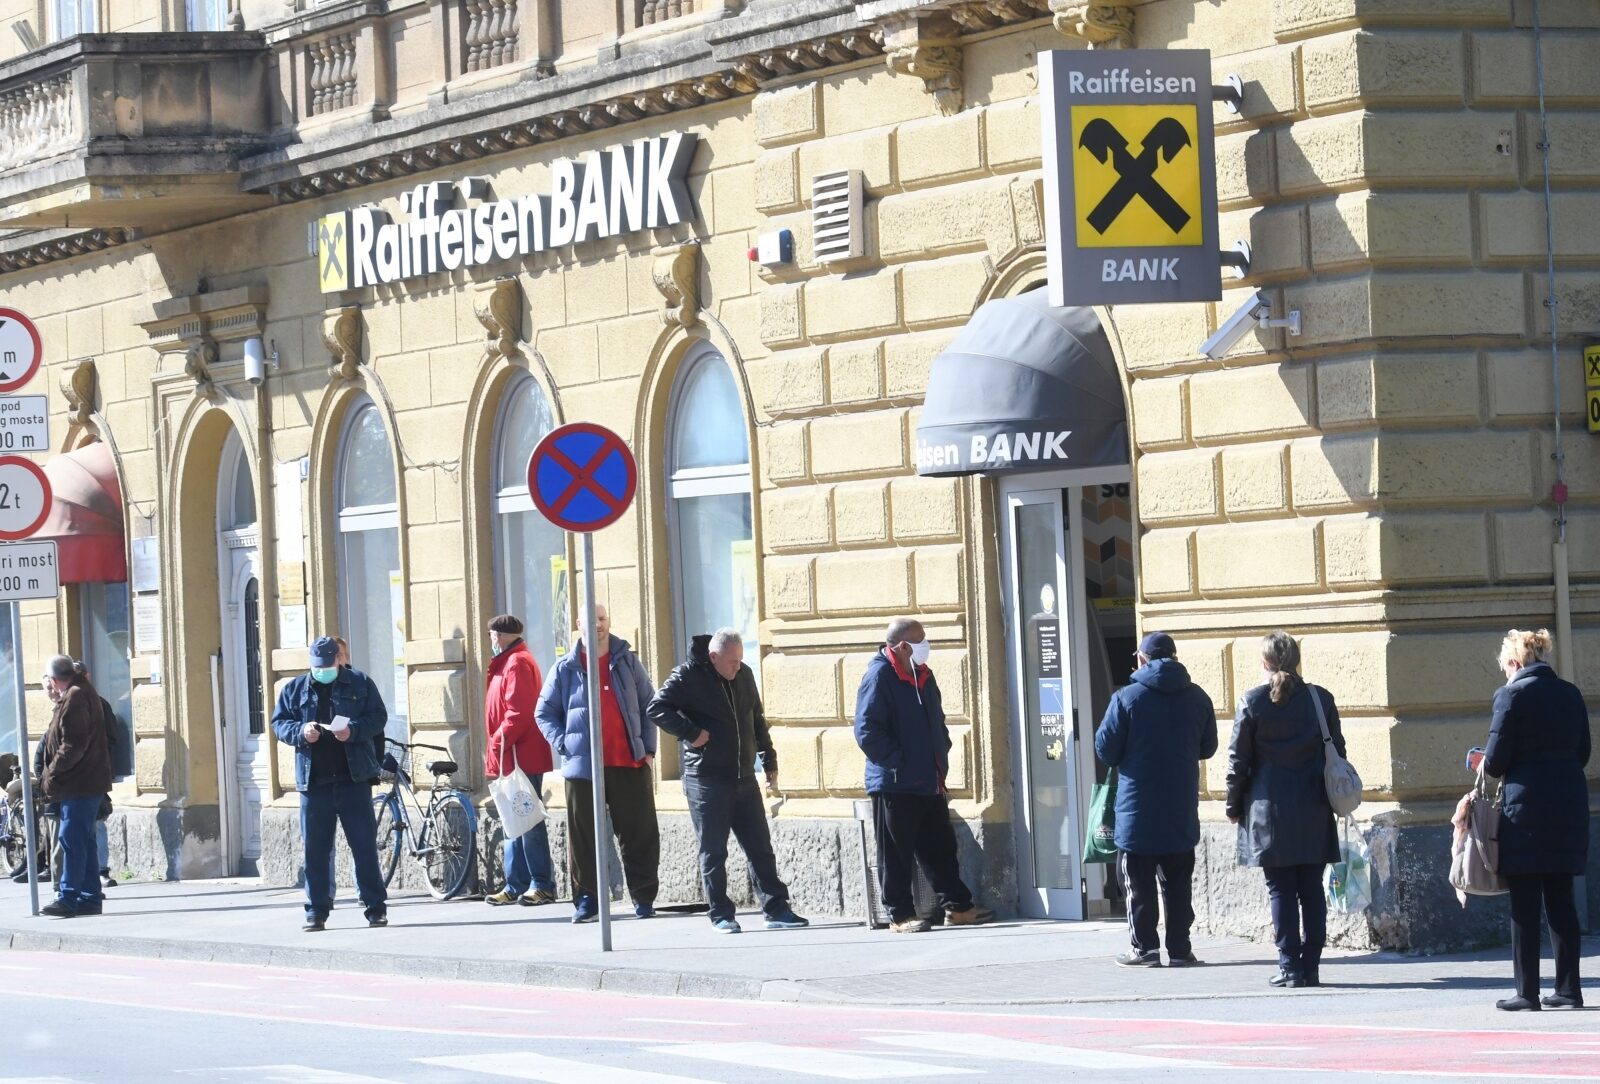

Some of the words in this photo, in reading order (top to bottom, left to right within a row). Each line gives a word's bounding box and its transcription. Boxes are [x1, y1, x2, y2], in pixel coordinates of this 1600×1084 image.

[1068, 68, 1197, 94] Raiffeisen
[352, 176, 544, 288] Raiffeisen
[549, 132, 683, 248] BANK
[1101, 257, 1180, 282] BANK
[4, 350, 17, 363] m
[0, 400, 21, 413] pod
[10, 414, 44, 425] mosta
[22, 435, 35, 448] m
[970, 430, 1073, 464] BANK
[19, 552, 53, 568] most
[0, 576, 21, 591] 00
[28, 578, 39, 590] m
